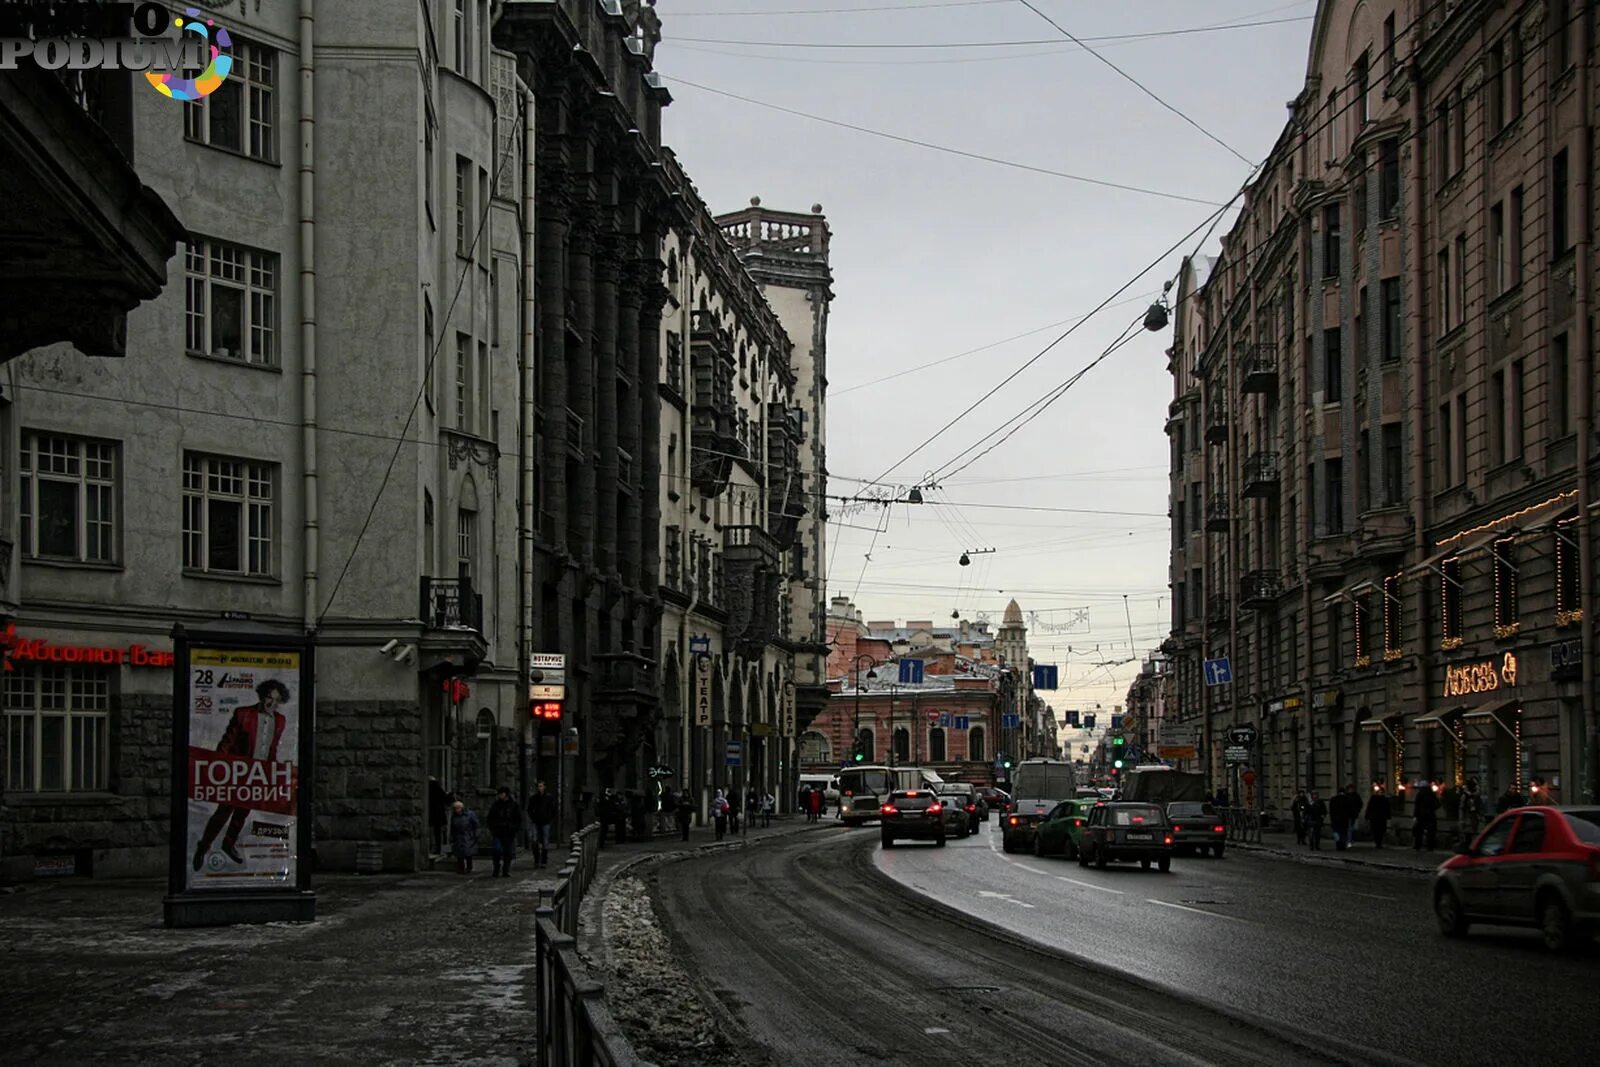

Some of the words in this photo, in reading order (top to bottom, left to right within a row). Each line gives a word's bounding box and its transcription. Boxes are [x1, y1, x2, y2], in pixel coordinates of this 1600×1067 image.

[14, 638, 125, 664] Абсолют
[195, 669, 213, 685] 28
[1443, 662, 1498, 697] ЛЮБОВЬ
[700, 678, 709, 723] ТЕАТР
[194, 760, 292, 785] ГОРАН
[193, 785, 292, 802] БРЕГОВИЧ
